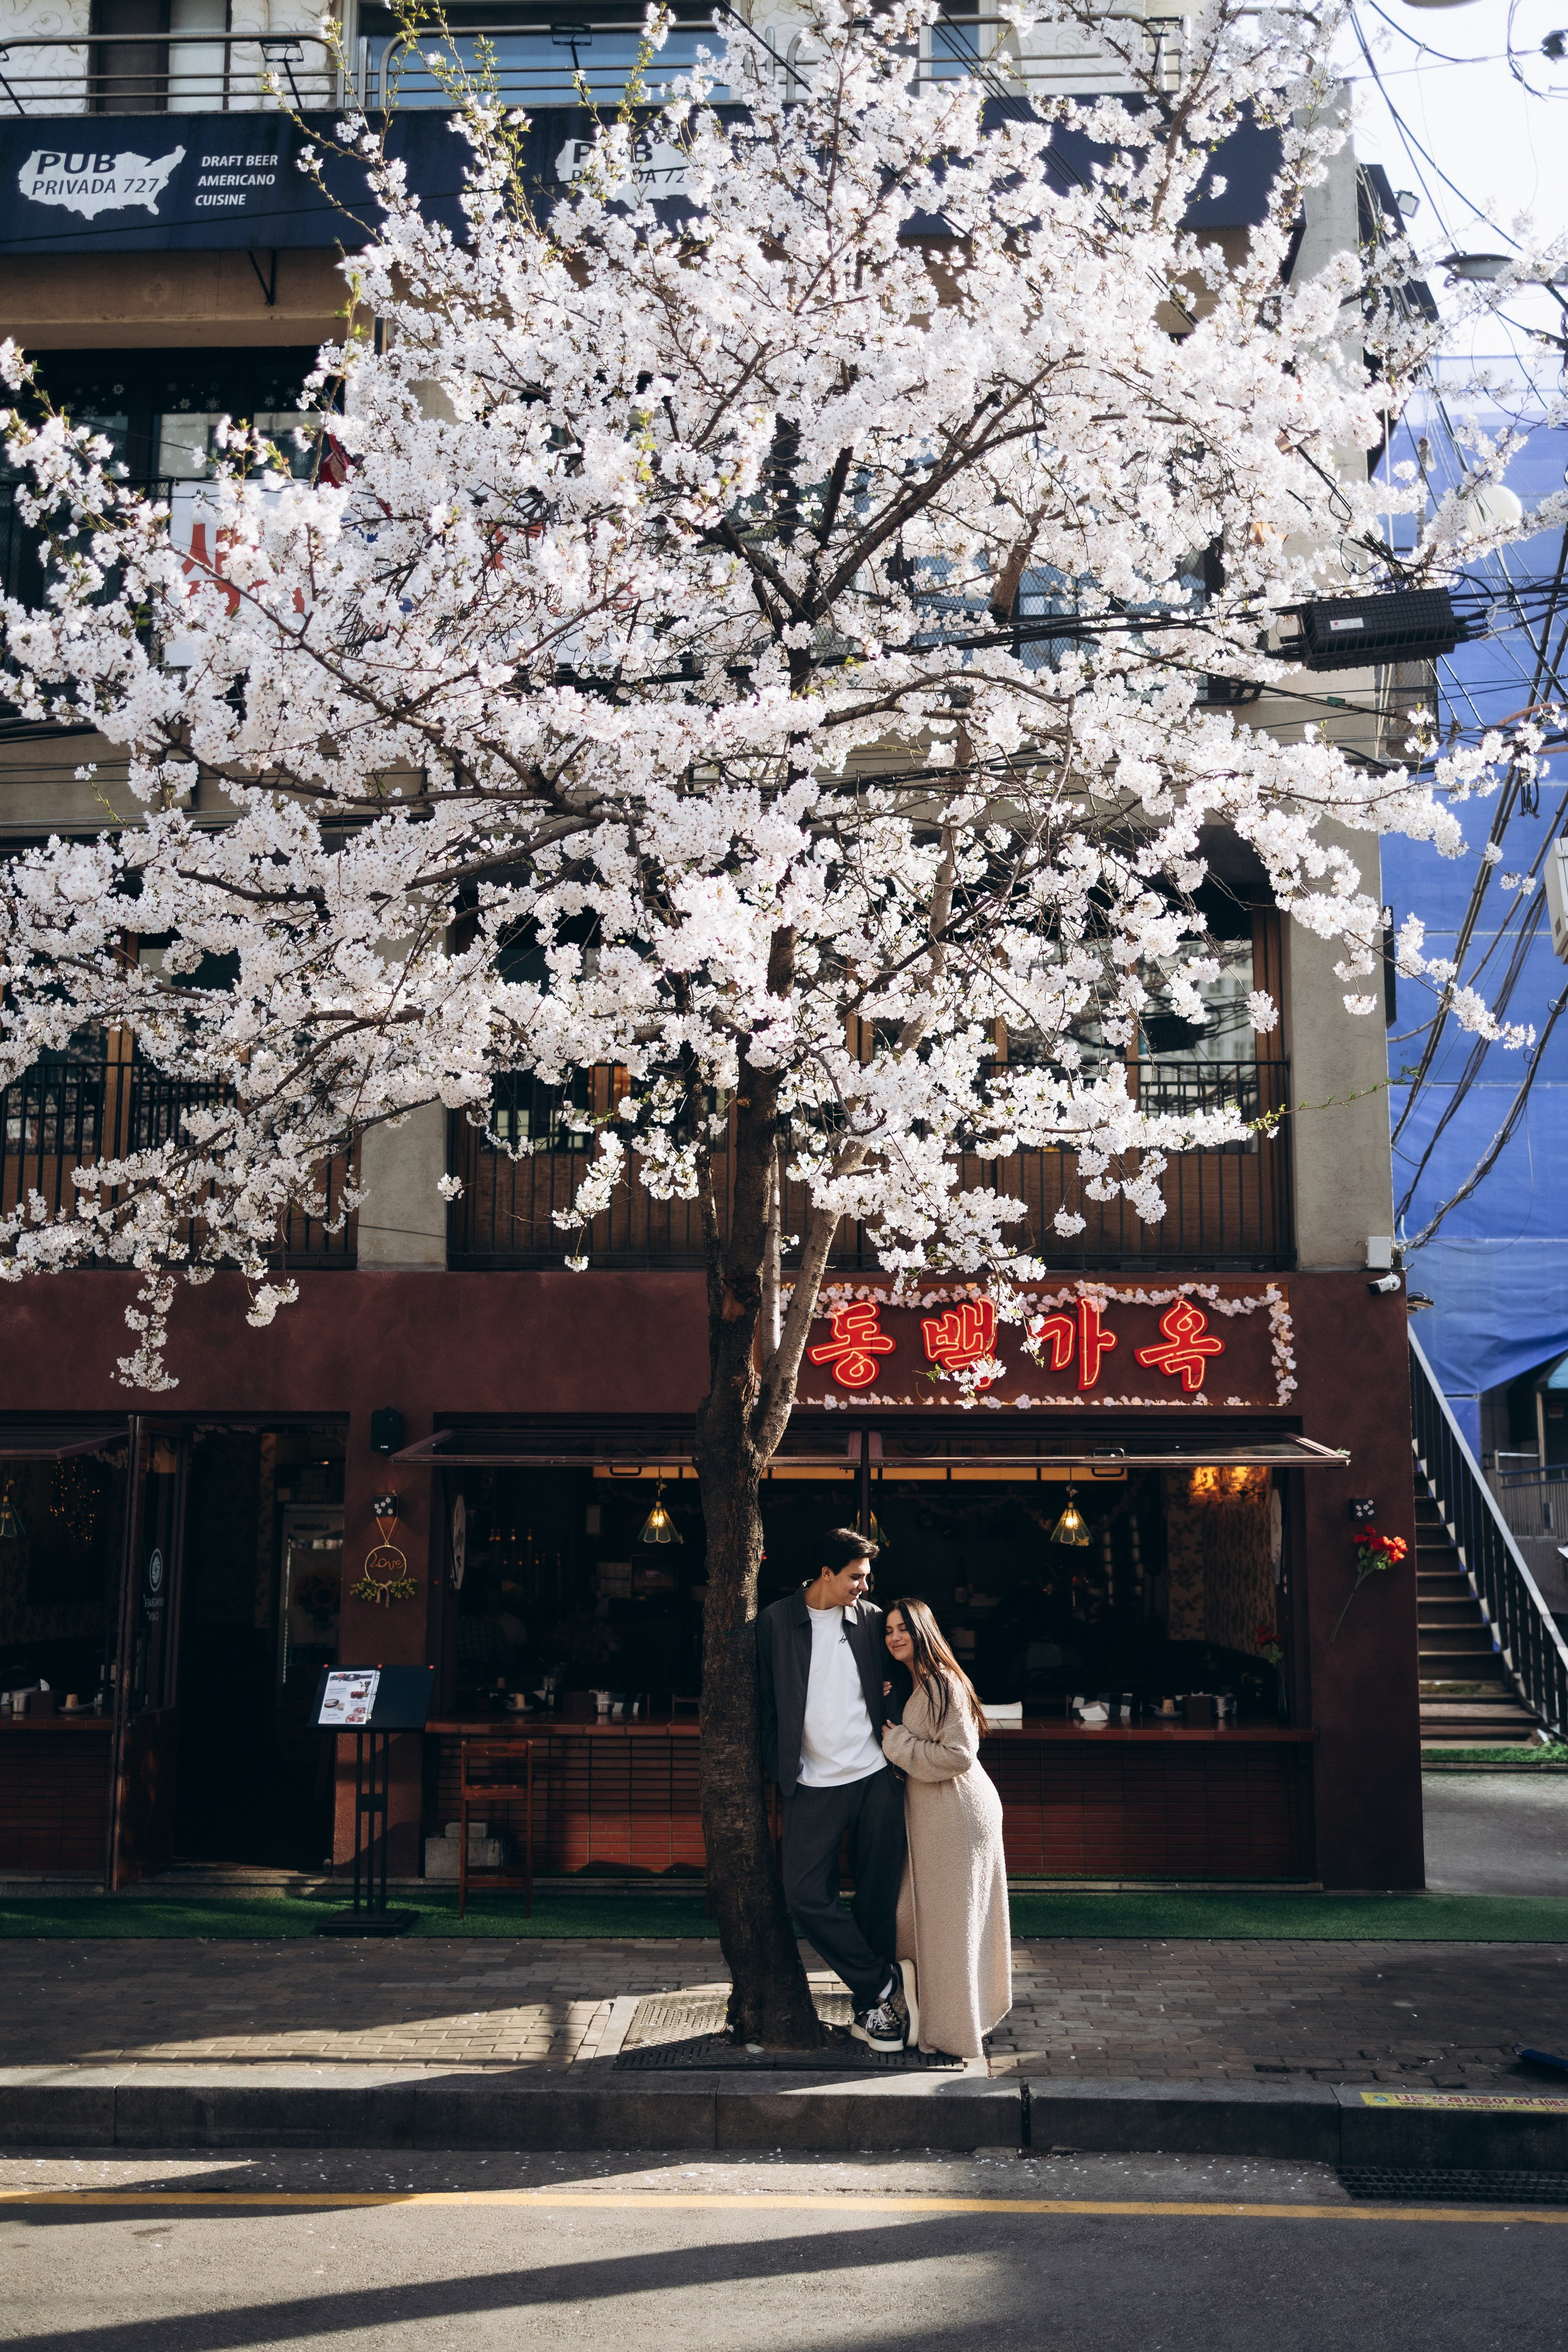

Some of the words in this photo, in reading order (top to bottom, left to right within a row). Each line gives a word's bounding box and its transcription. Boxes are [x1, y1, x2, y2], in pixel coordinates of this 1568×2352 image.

[37, 153, 116, 175] PUB
[202, 156, 244, 167] DRAFT
[246, 155, 279, 166] BEER
[32, 179, 116, 195] PRIVADA
[124, 178, 160, 193] 727
[197, 174, 276, 186] AMERICANO
[195, 194, 246, 206] CUISINE
[807, 1297, 1224, 1392] 동백가옥
[370, 1551, 405, 1570] Love
[1432, 2095, 1509, 2105] 쓰레기통이
